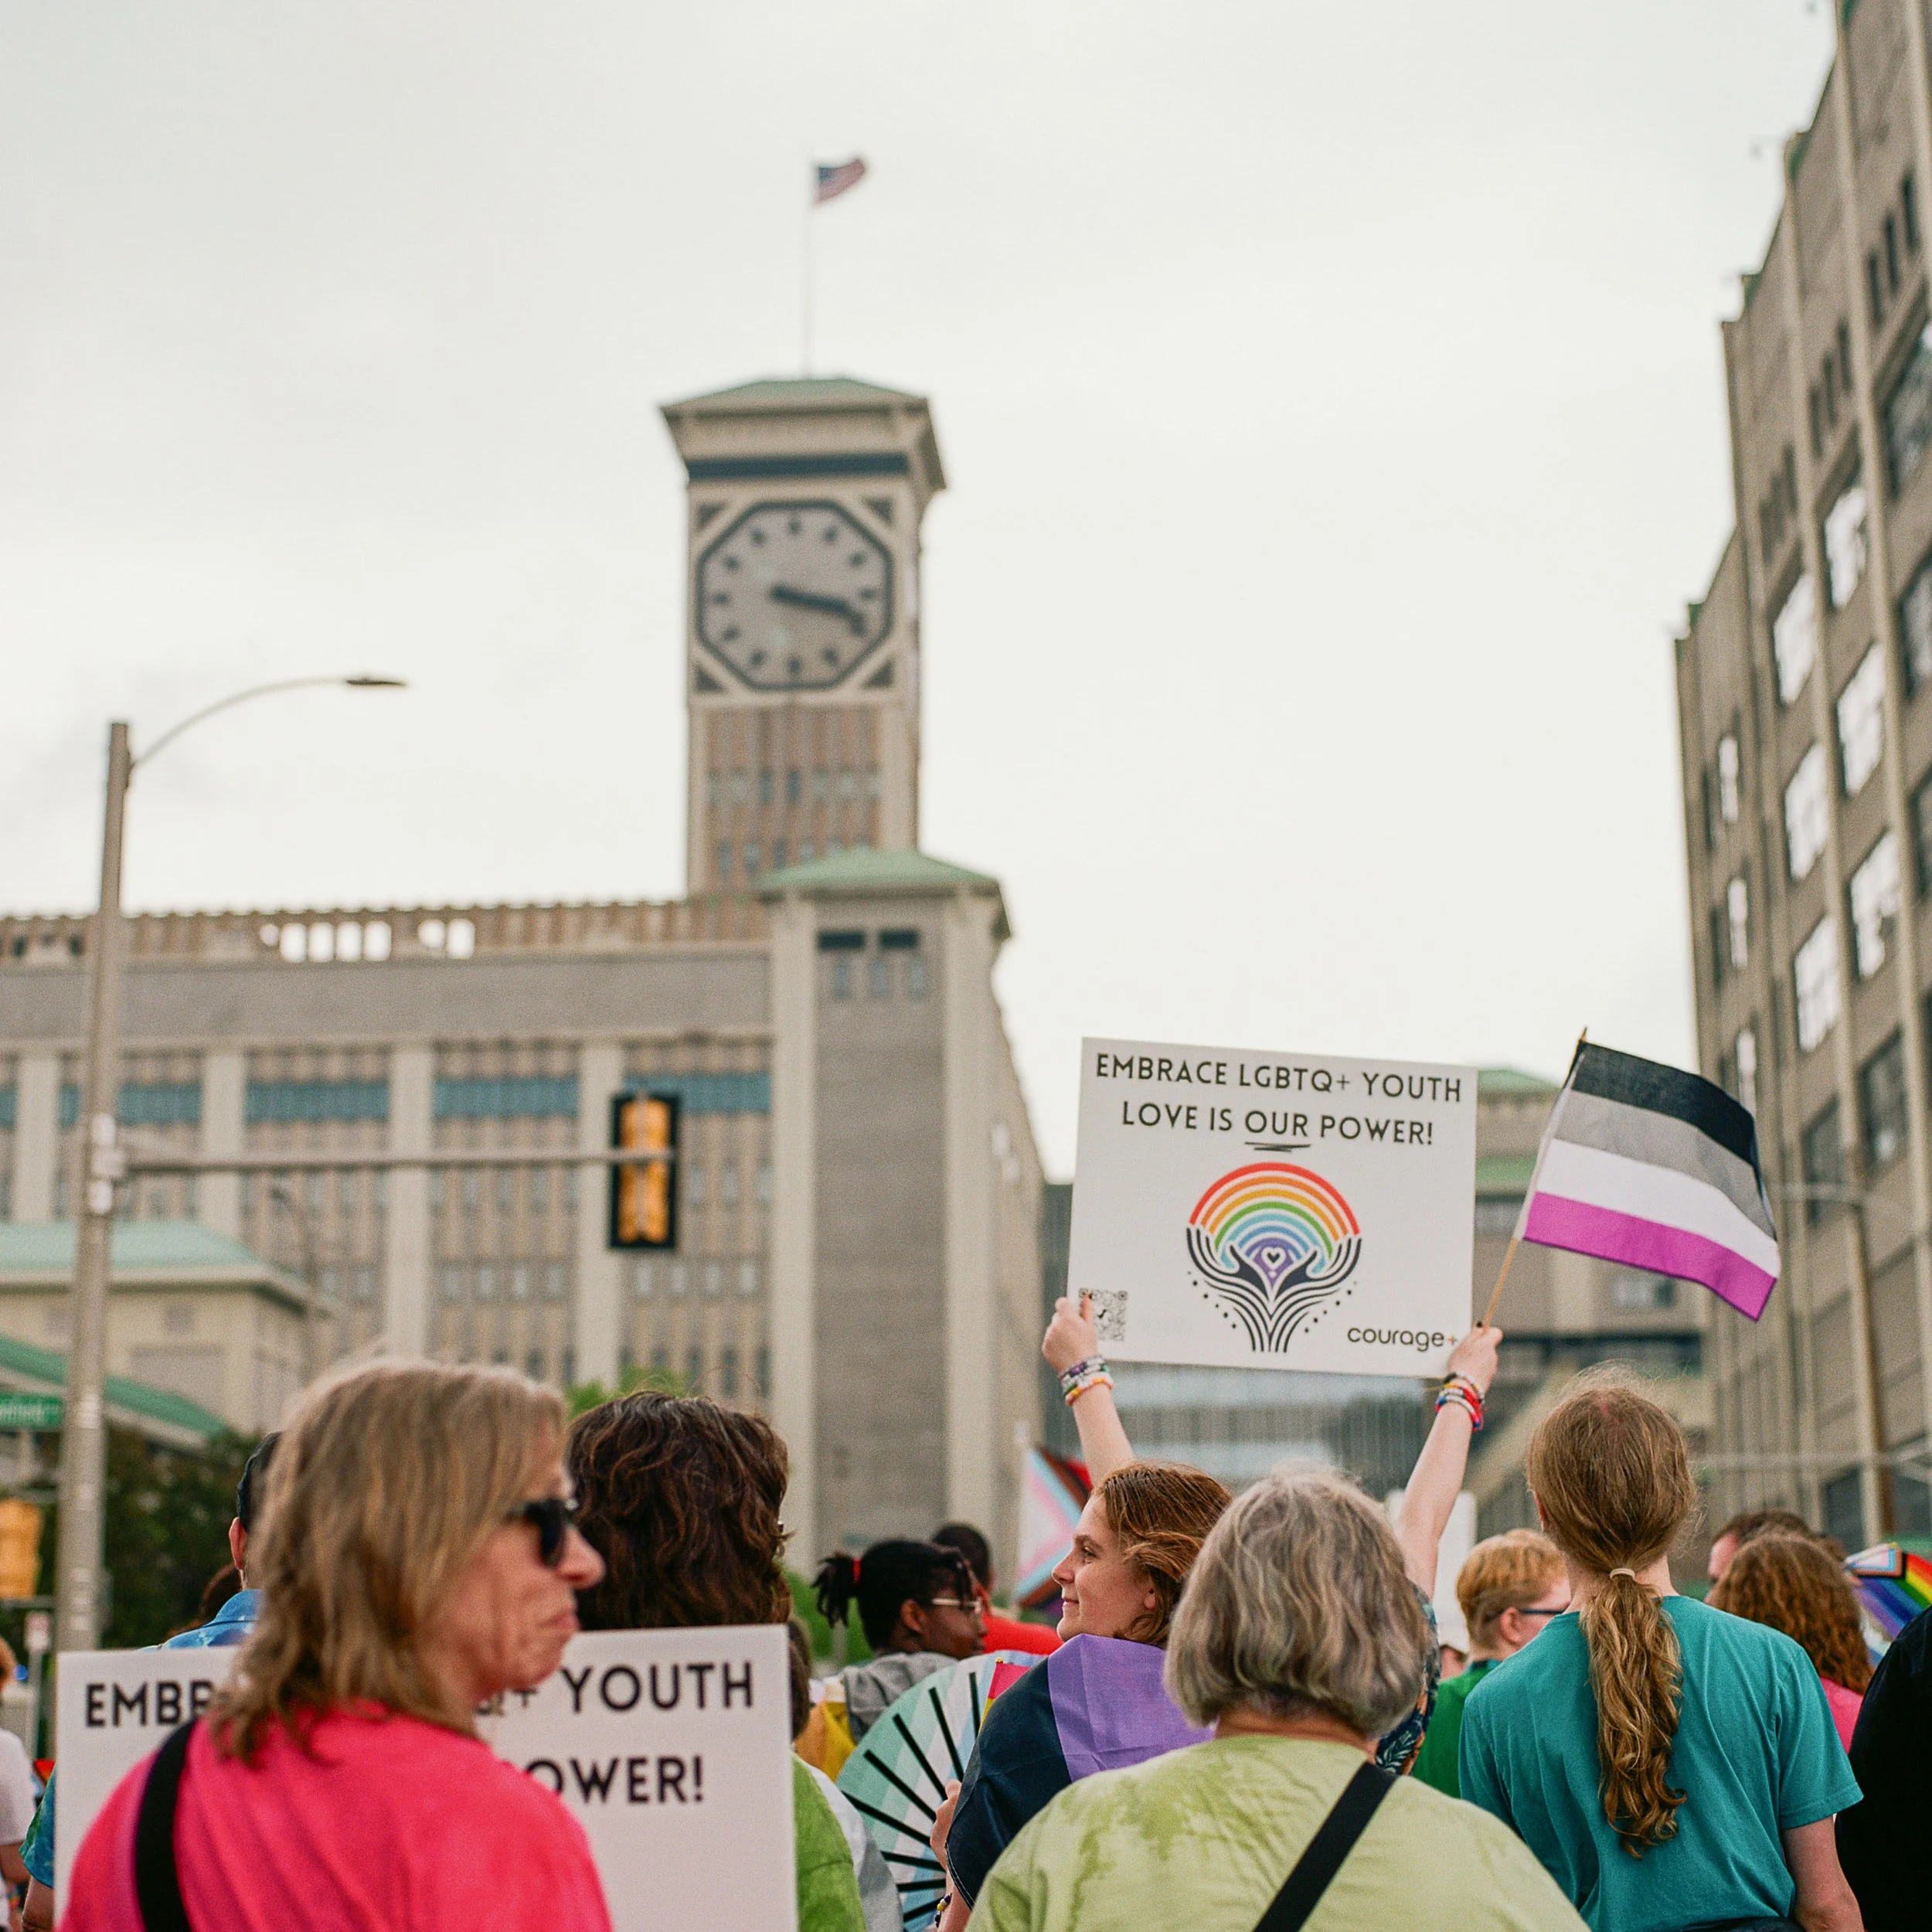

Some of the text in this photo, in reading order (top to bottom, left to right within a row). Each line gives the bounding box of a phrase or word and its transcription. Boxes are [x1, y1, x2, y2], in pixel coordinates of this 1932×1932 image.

[1095, 1052, 1462, 1104] EMBRACE LGBTQ+ YOUTH
[1121, 1100, 1434, 1145] LOVE IS OUR POWER!
[559, 1661, 753, 1714] YOUTH
[526, 1755, 704, 1804] OWER!
